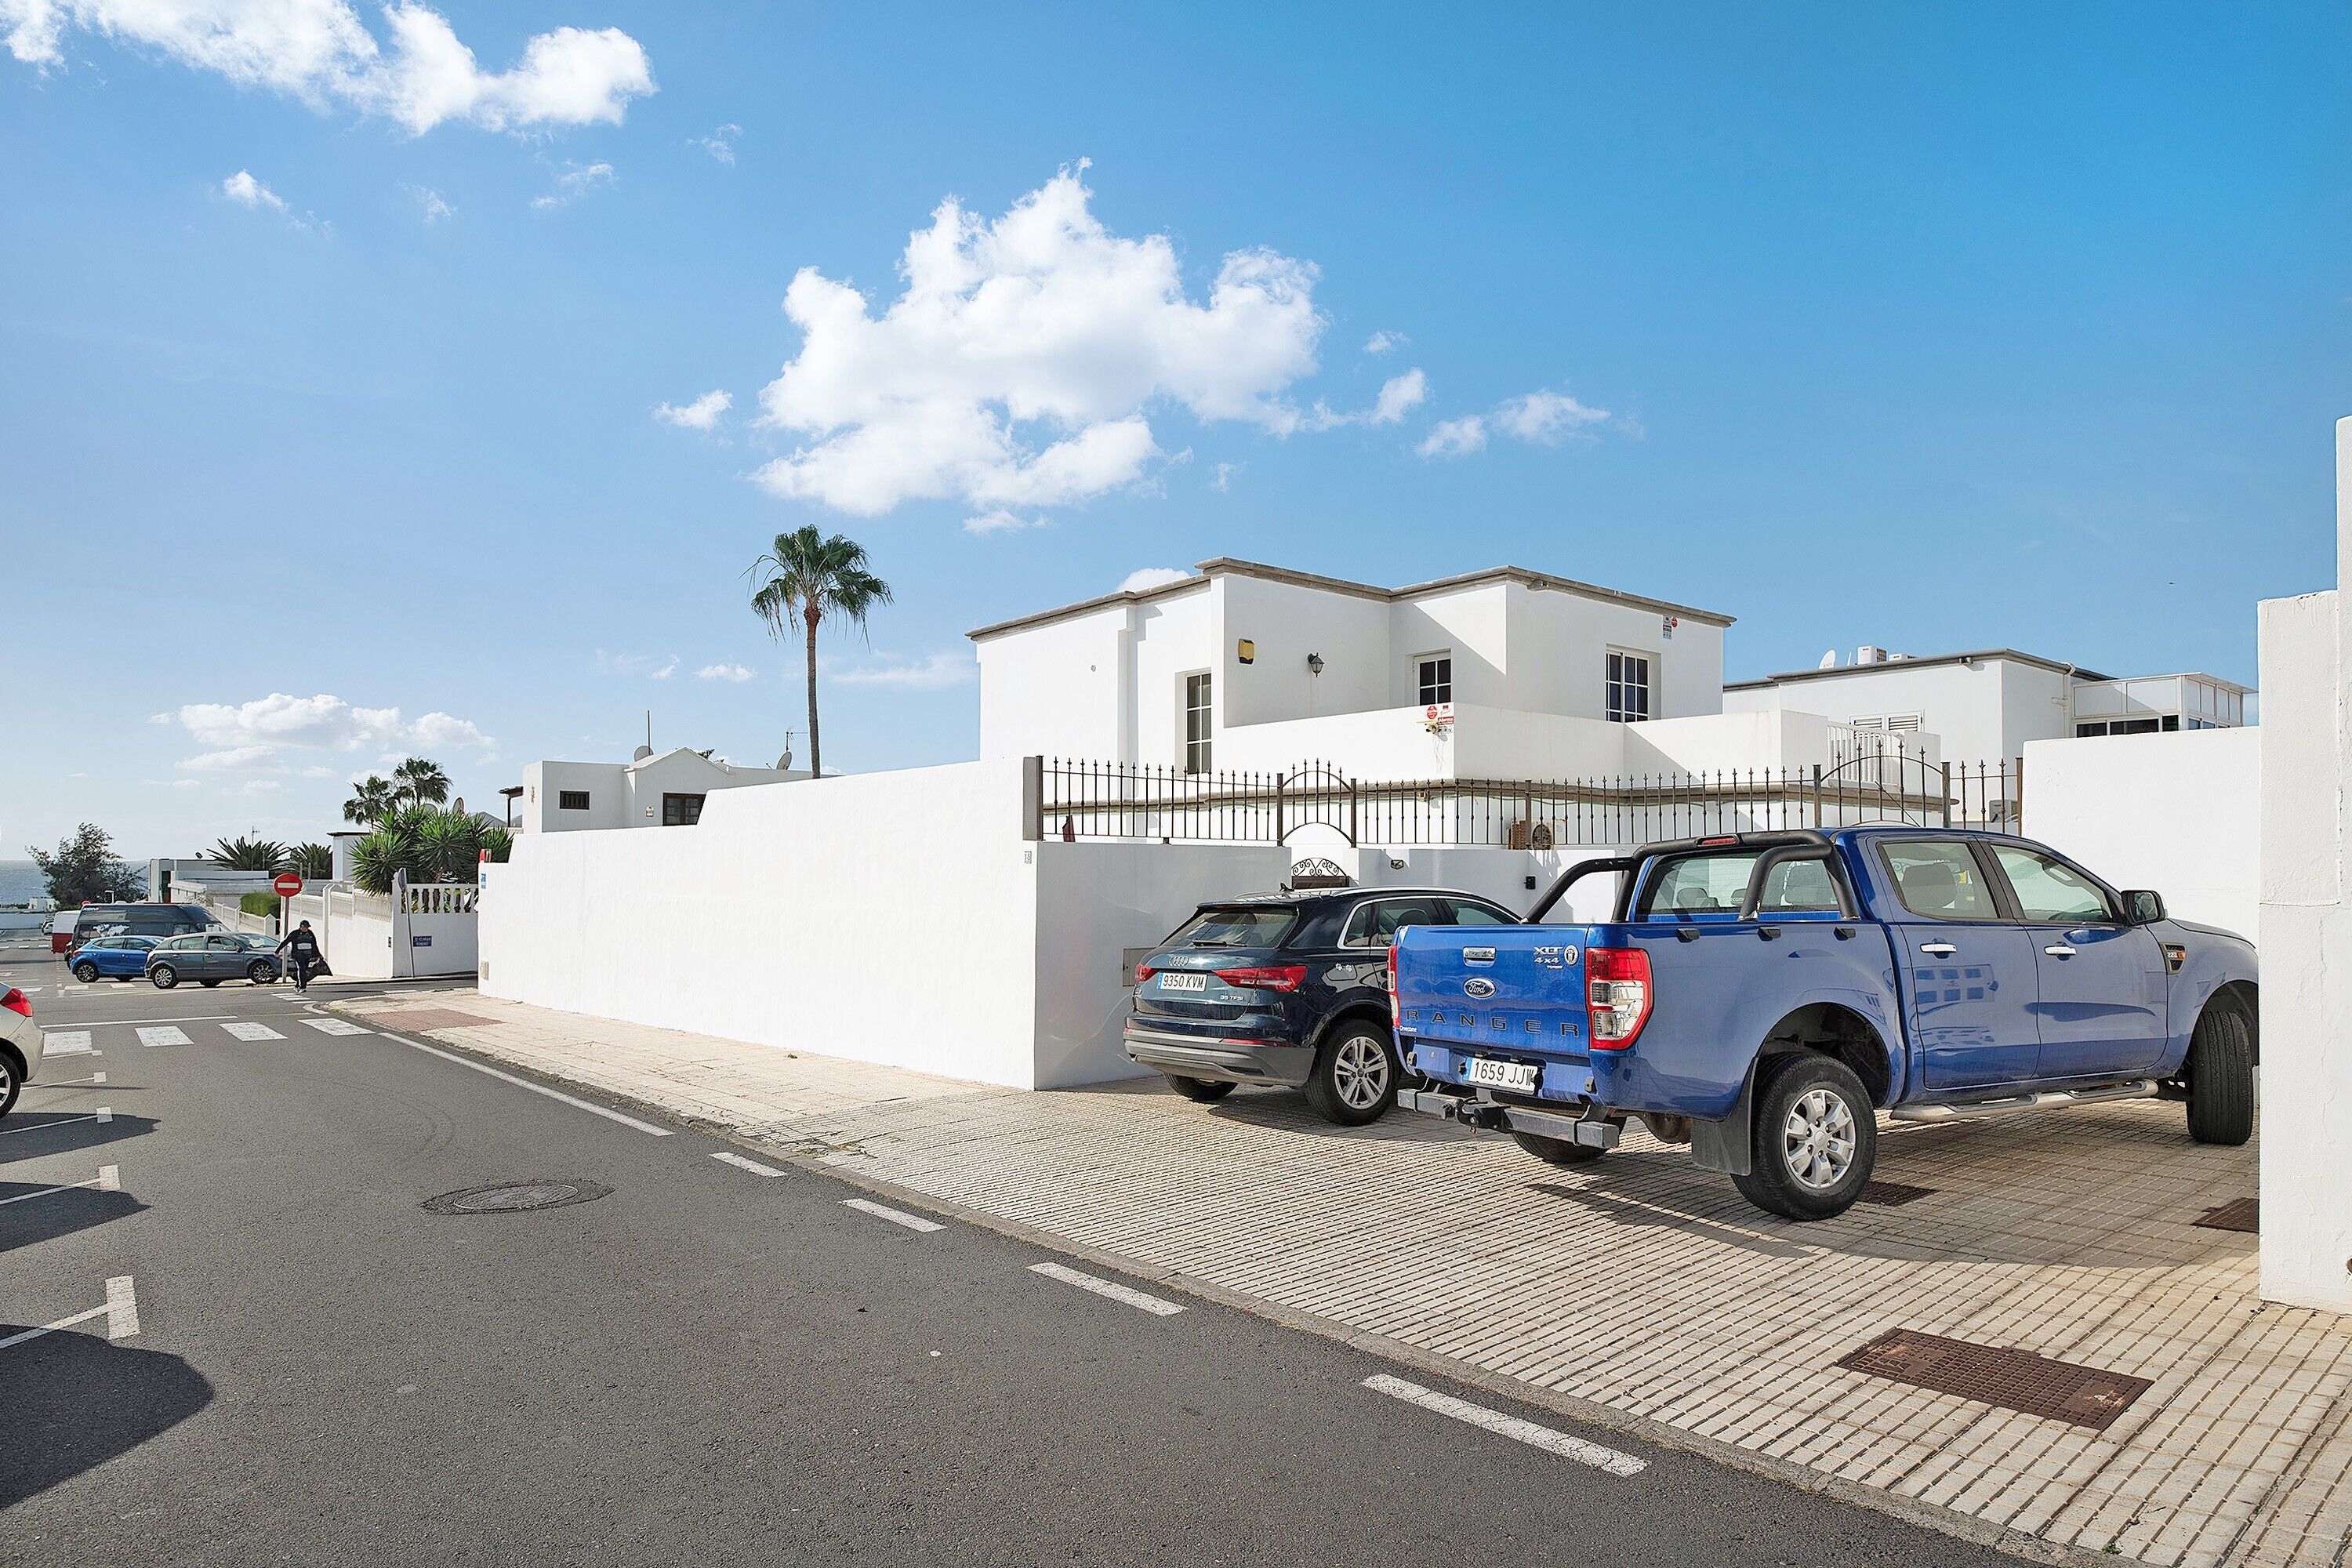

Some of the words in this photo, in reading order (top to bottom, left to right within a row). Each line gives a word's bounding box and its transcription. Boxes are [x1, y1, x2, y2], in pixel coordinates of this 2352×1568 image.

[1163, 975, 1185, 988] 9350
[1186, 975, 1204, 989] KVM
[1468, 982, 1486, 993] Ford
[1406, 1010, 1579, 1038] RANGER
[1474, 1062, 1505, 1082] 1659
